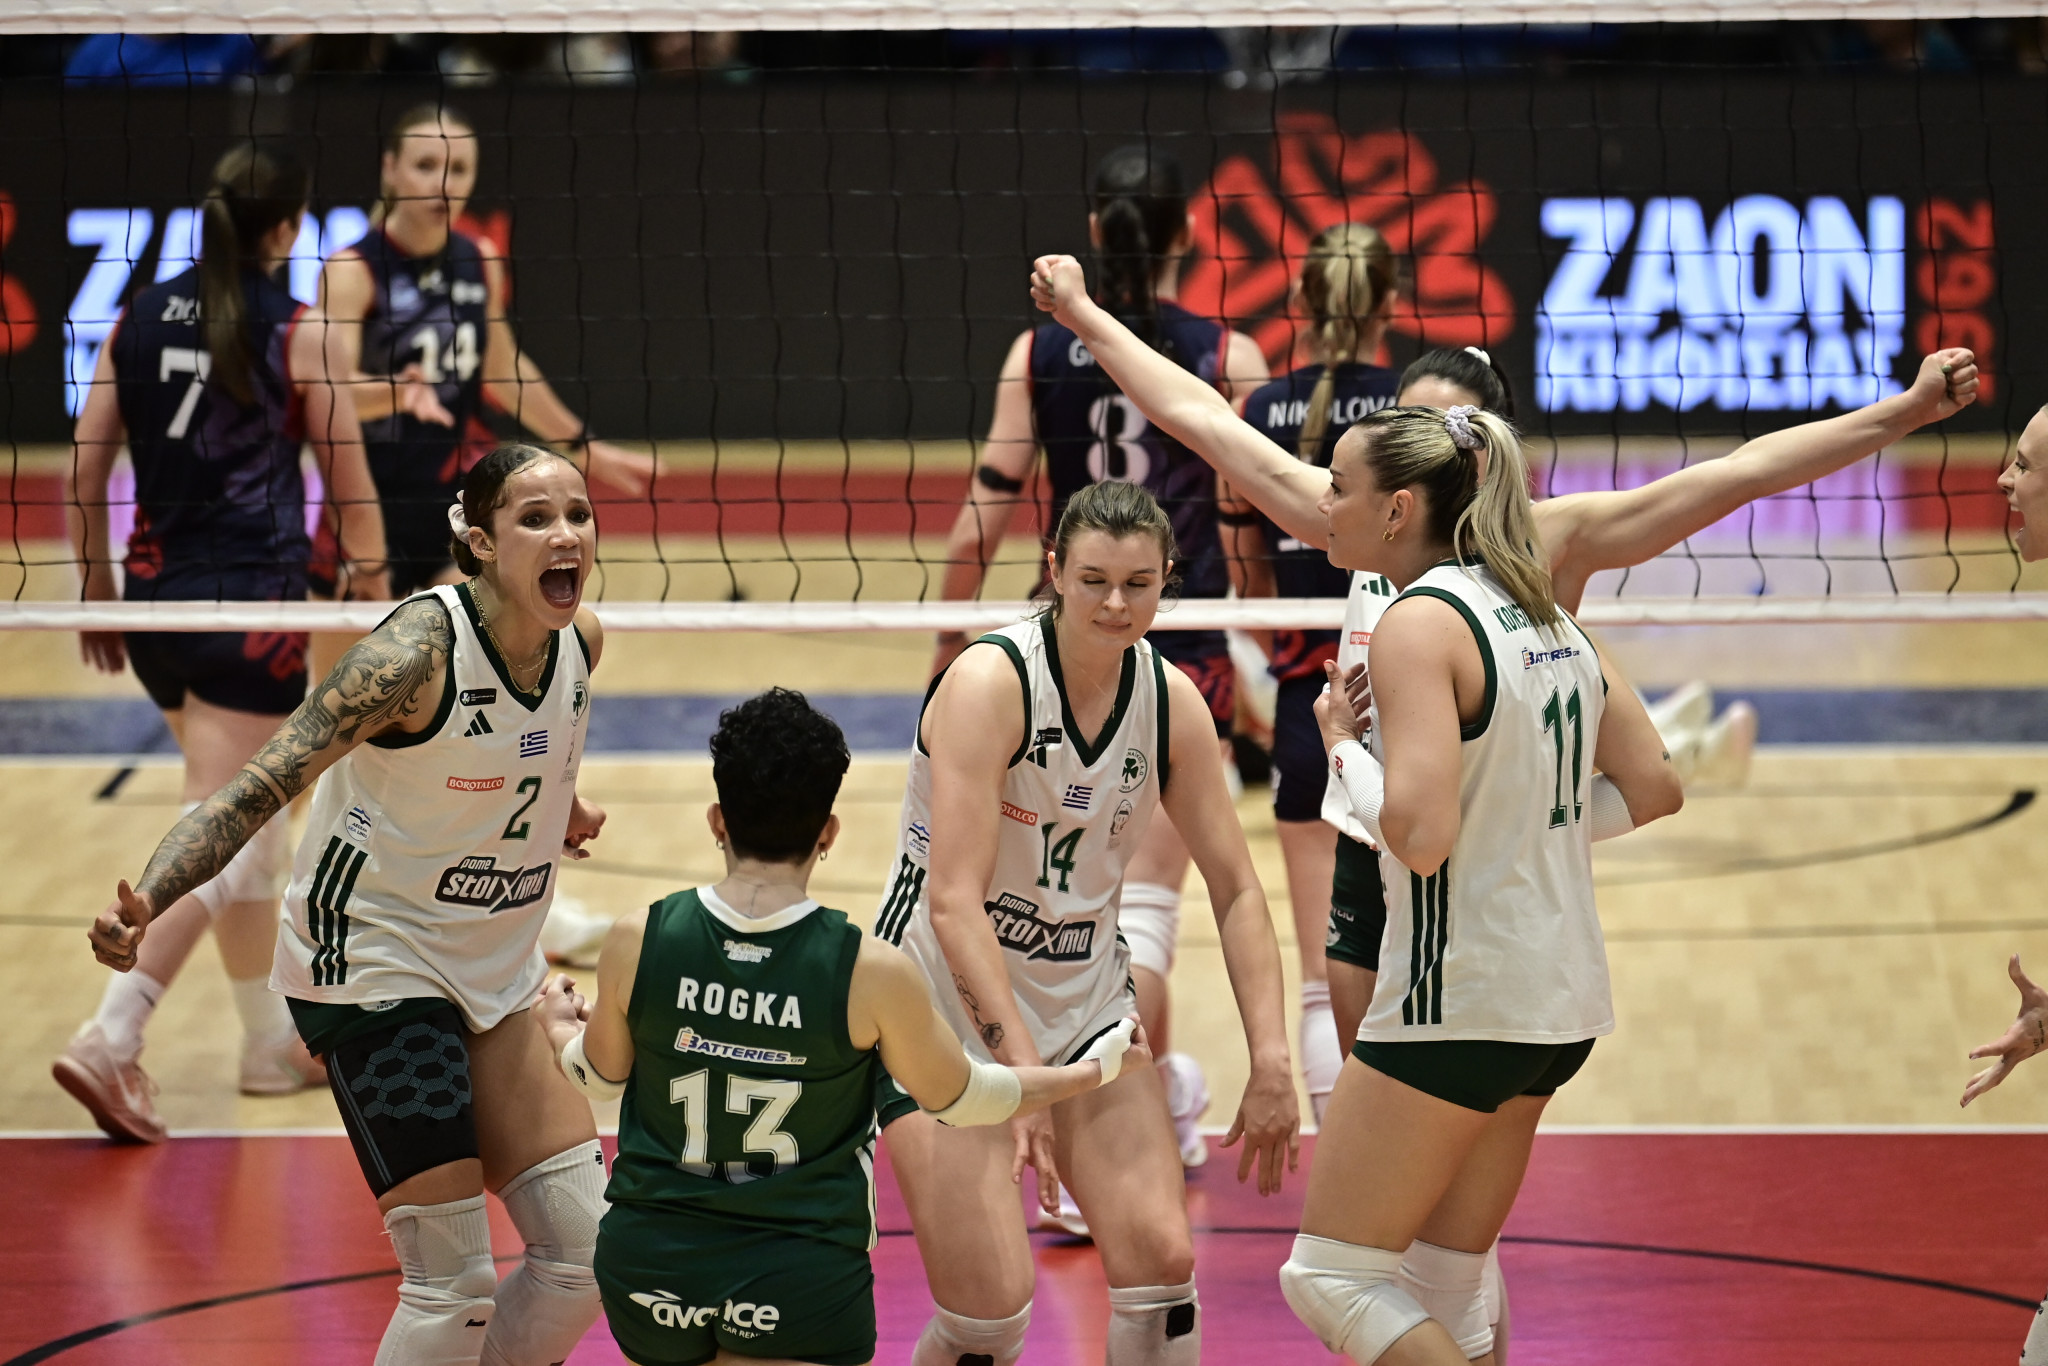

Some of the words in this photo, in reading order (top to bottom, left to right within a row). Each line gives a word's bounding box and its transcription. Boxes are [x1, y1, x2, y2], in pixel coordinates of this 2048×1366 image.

[1540, 194, 1906, 322] ZAON
[1915, 198, 1997, 406] 962
[411, 322, 480, 384] 14
[160, 346, 212, 439] 7
[1267, 396, 1397, 428] NIKLOV
[1542, 681, 1583, 829] 11
[449, 779, 503, 791] BOROTALCO
[500, 776, 543, 840] 2
[1001, 803, 1036, 823] OTALCO
[460, 857, 492, 870] pame
[1035, 822, 1088, 894] 14
[999, 895, 1035, 914] pame
[676, 977, 802, 1029] ROGKA
[684, 1035, 806, 1064] BATTERIES.GR
[669, 1068, 803, 1185] 13
[721, 1323, 737, 1336] CAR
